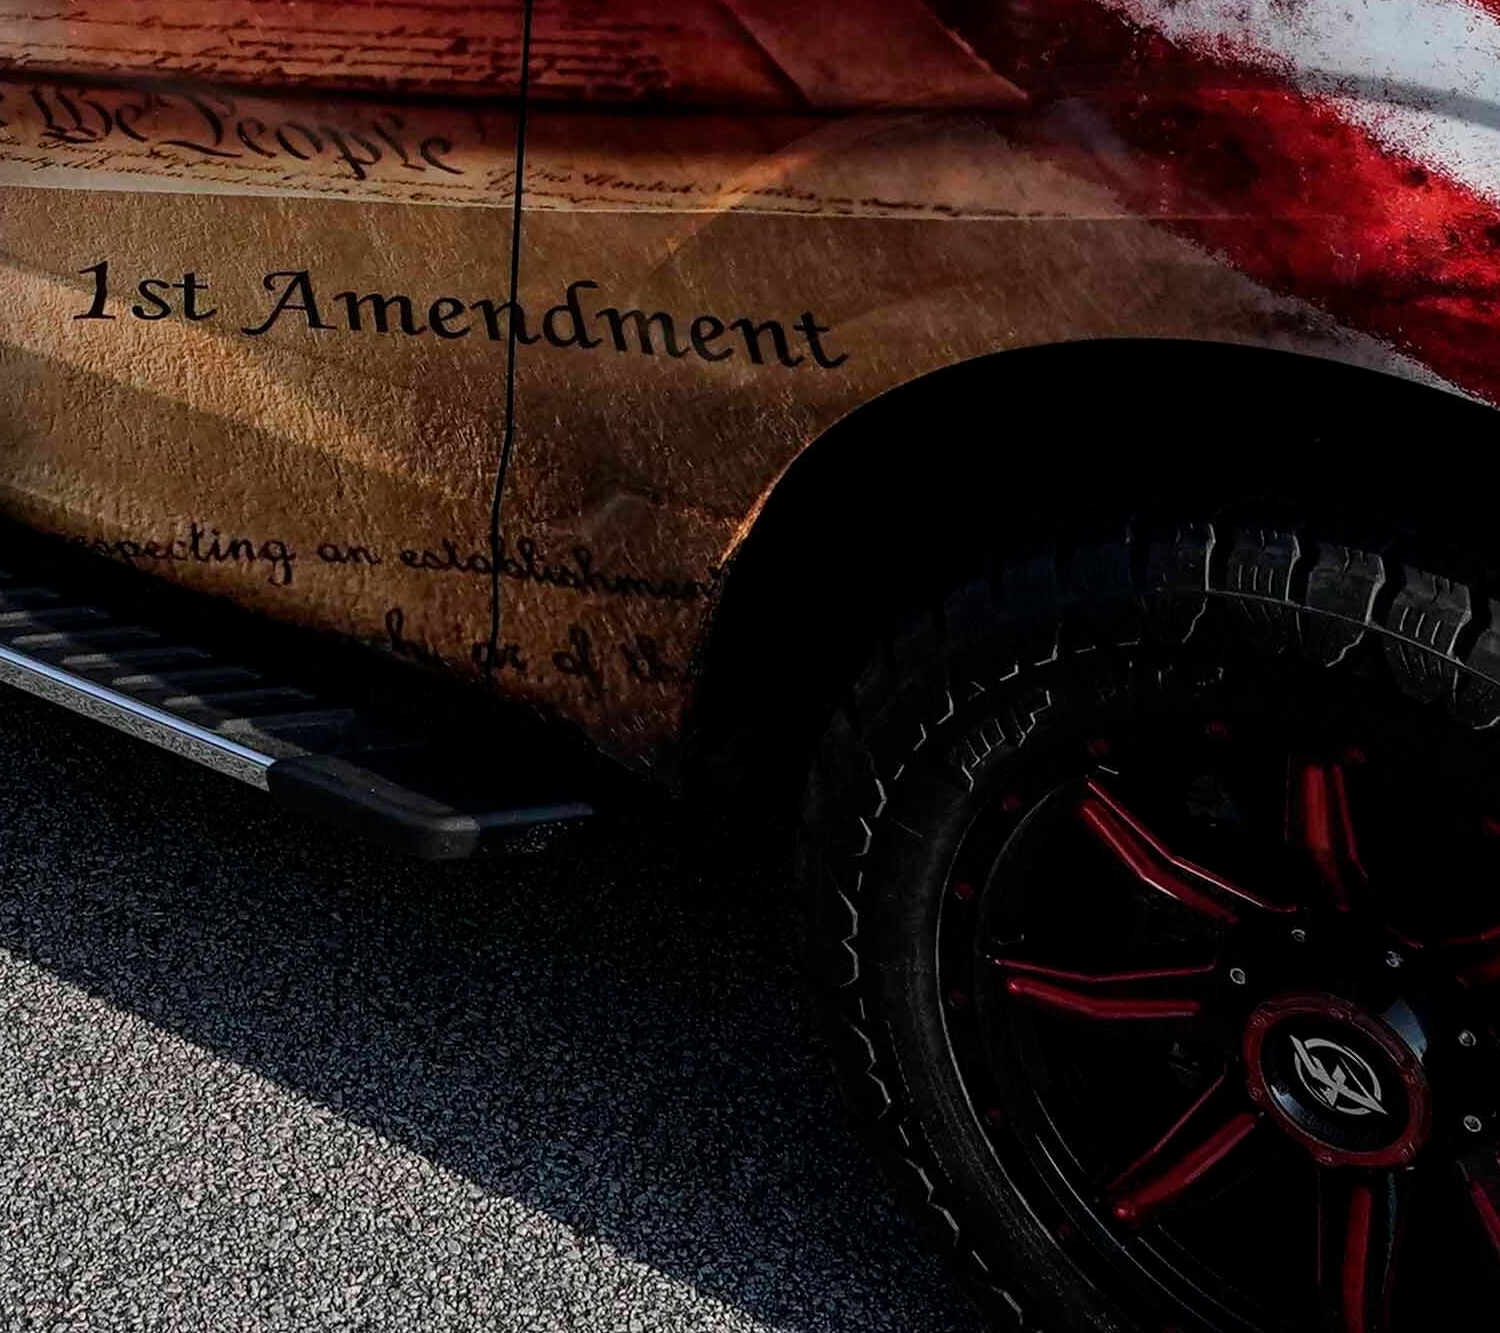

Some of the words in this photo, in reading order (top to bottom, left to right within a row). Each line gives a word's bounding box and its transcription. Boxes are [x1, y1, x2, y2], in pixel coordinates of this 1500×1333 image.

[160, 85, 463, 180] People
[72, 259, 218, 322] 1st
[239, 268, 850, 371] Amendment
[315, 539, 383, 566] an
